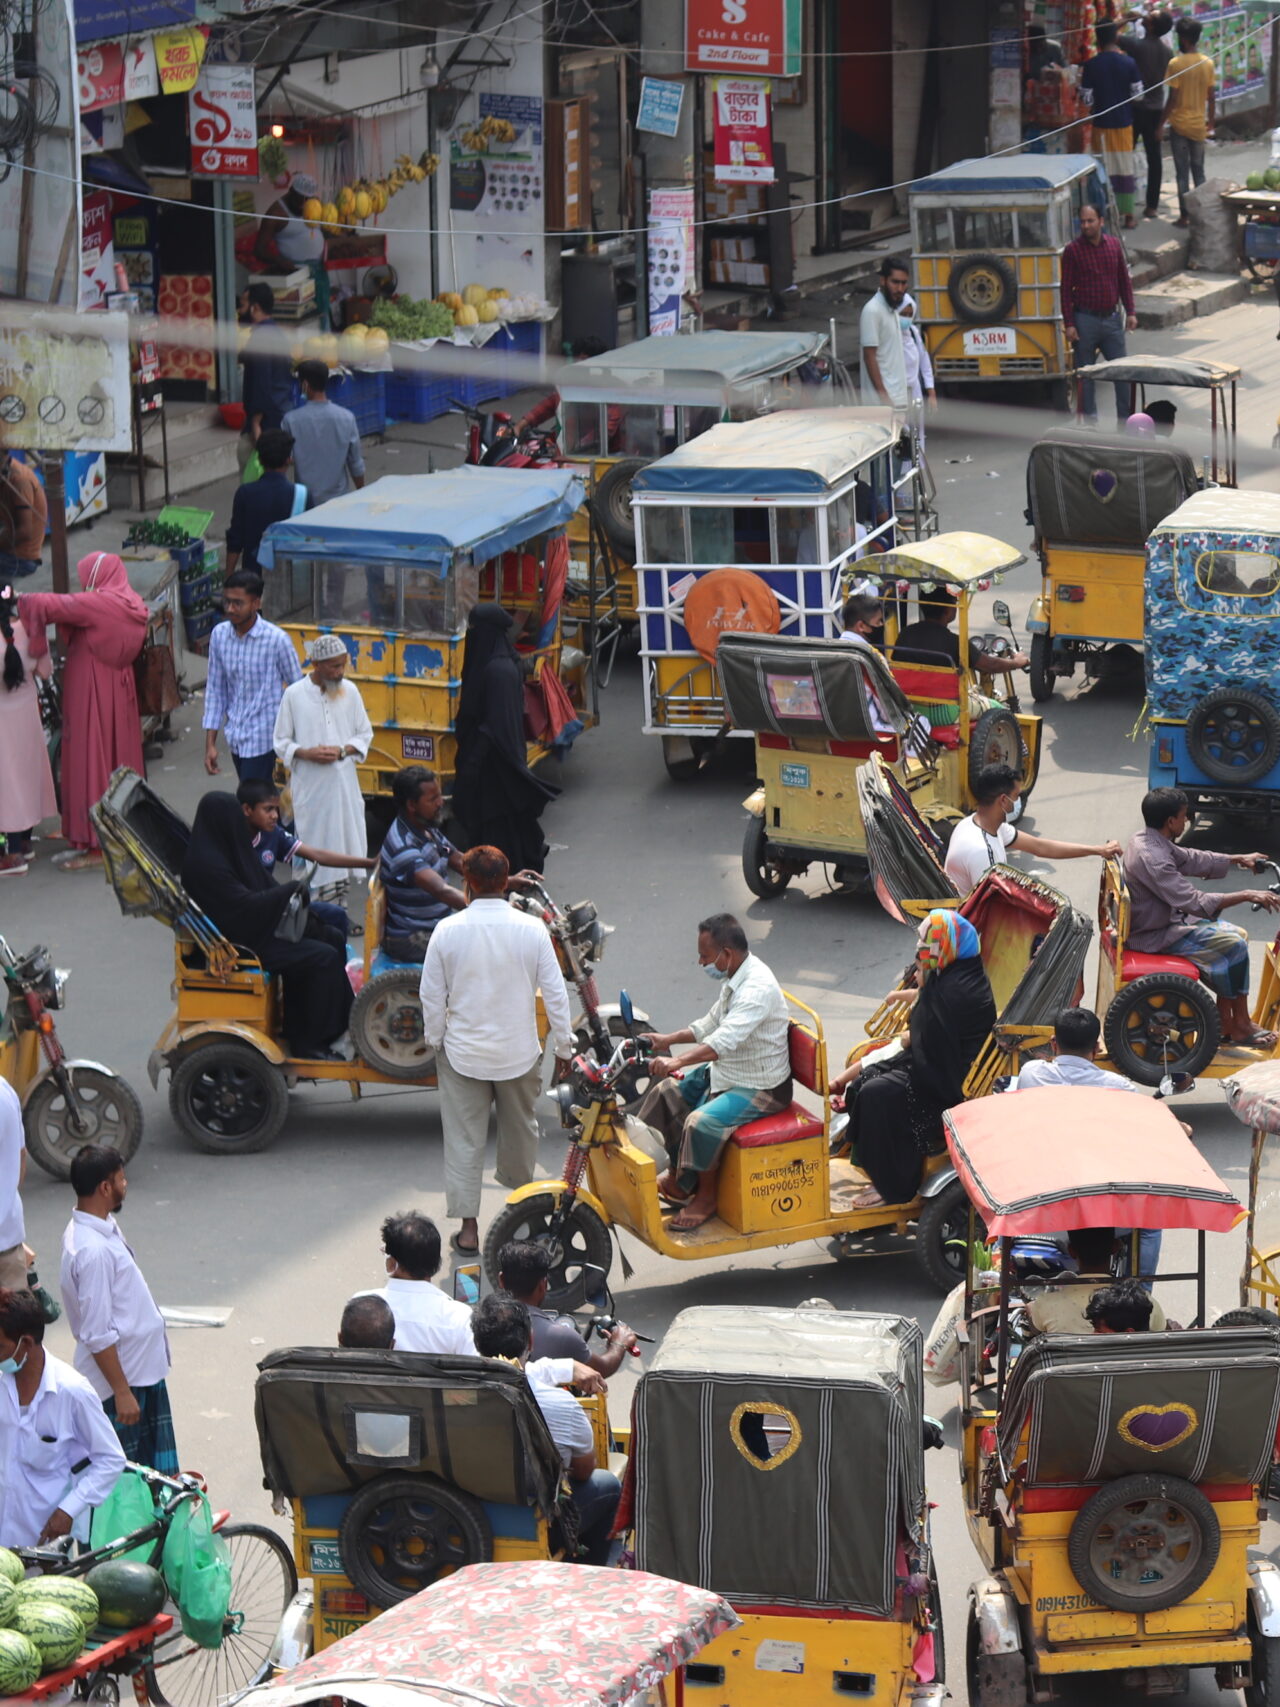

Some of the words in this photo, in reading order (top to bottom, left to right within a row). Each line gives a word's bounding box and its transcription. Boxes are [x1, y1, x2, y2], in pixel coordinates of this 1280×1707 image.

[698, 28, 726, 40] Cake
[731, 31, 739, 40] &
[744, 32, 770, 42] Cafe
[164, 45, 192, 62] খরচ
[707, 48, 728, 59] 2nd
[731, 50, 761, 61] Floor
[160, 63, 199, 83] কমলো
[724, 92, 760, 108] বাড়বে
[729, 106, 758, 122] টাকা
[706, 620, 755, 631] POWER
[313, 1543, 340, 1556] মিশু
